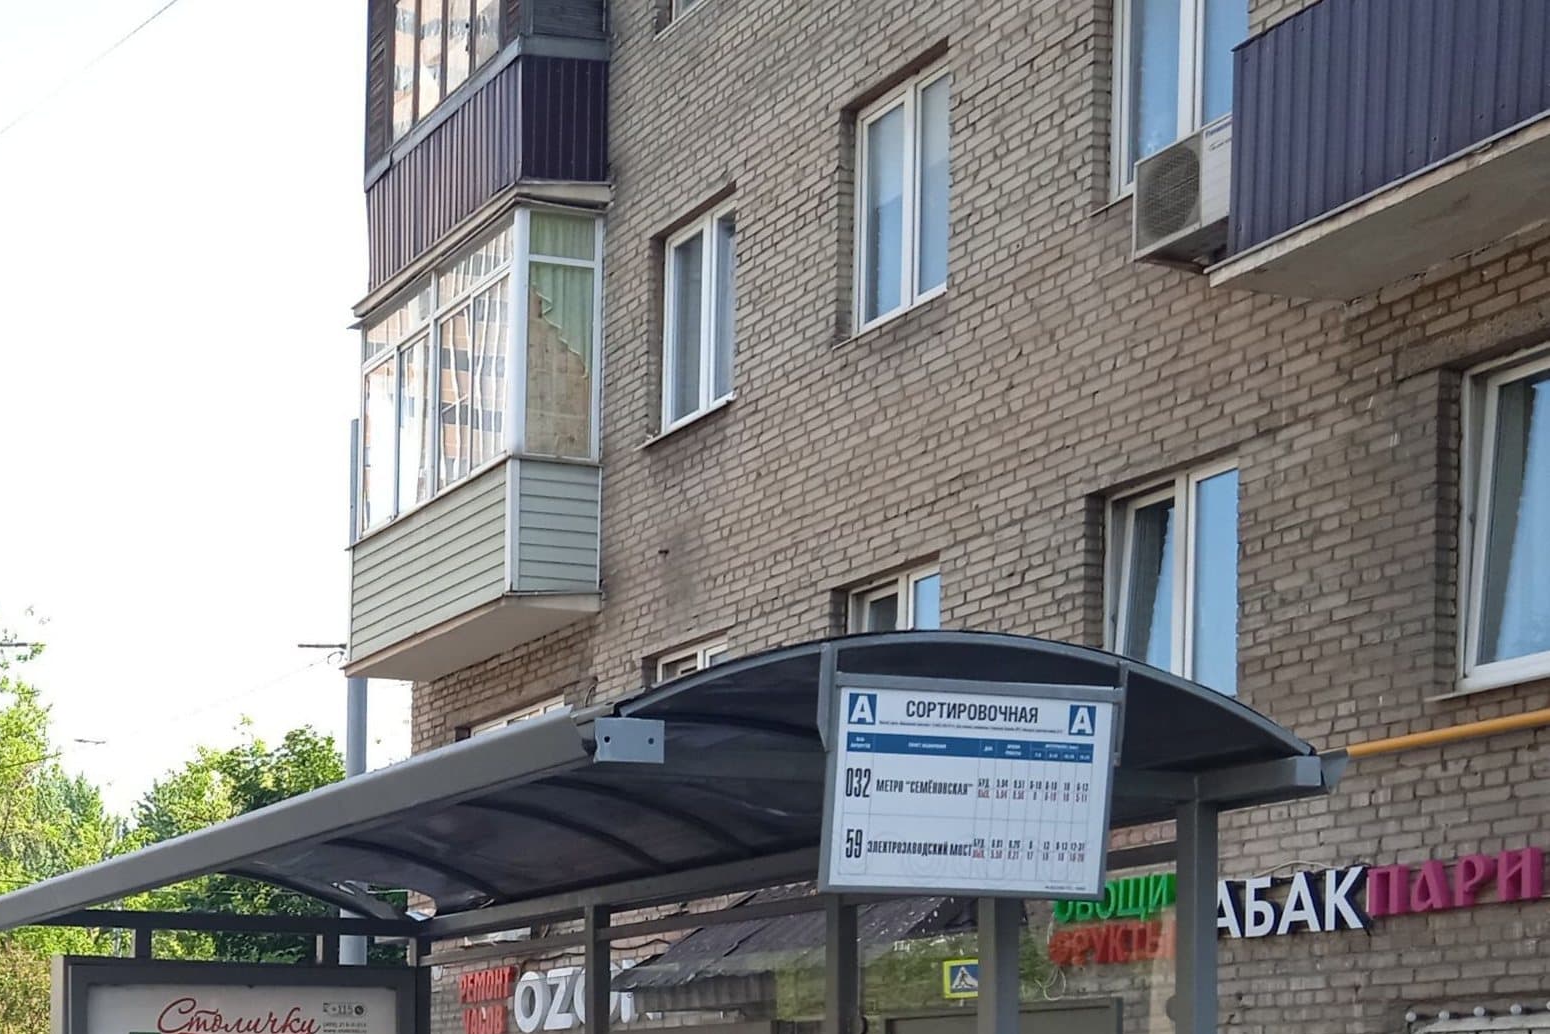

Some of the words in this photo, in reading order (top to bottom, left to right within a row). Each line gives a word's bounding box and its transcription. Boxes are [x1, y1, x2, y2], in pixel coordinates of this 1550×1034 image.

[849, 695, 874, 723] А
[906, 700, 1038, 724] СОРТИРОВОЧНАЯ
[1069, 706, 1093, 734] А
[845, 768, 871, 798] 032
[876, 779, 904, 792] МЕТРО
[845, 829, 863, 859] 59
[867, 840, 948, 857] ЭЛЕКТРОЗАВОДСКИЙ
[949, 843, 973, 857] МОСТ
[1052, 873, 1176, 922] ОВОЩИ
[1367, 846, 1545, 918] ПАРИ
[1217, 865, 1366, 938] АБАК
[1048, 919, 1176, 966] ФРУКТЫ
[458, 965, 515, 1005] РЕМОНТ
[157, 997, 320, 1034] Столички
